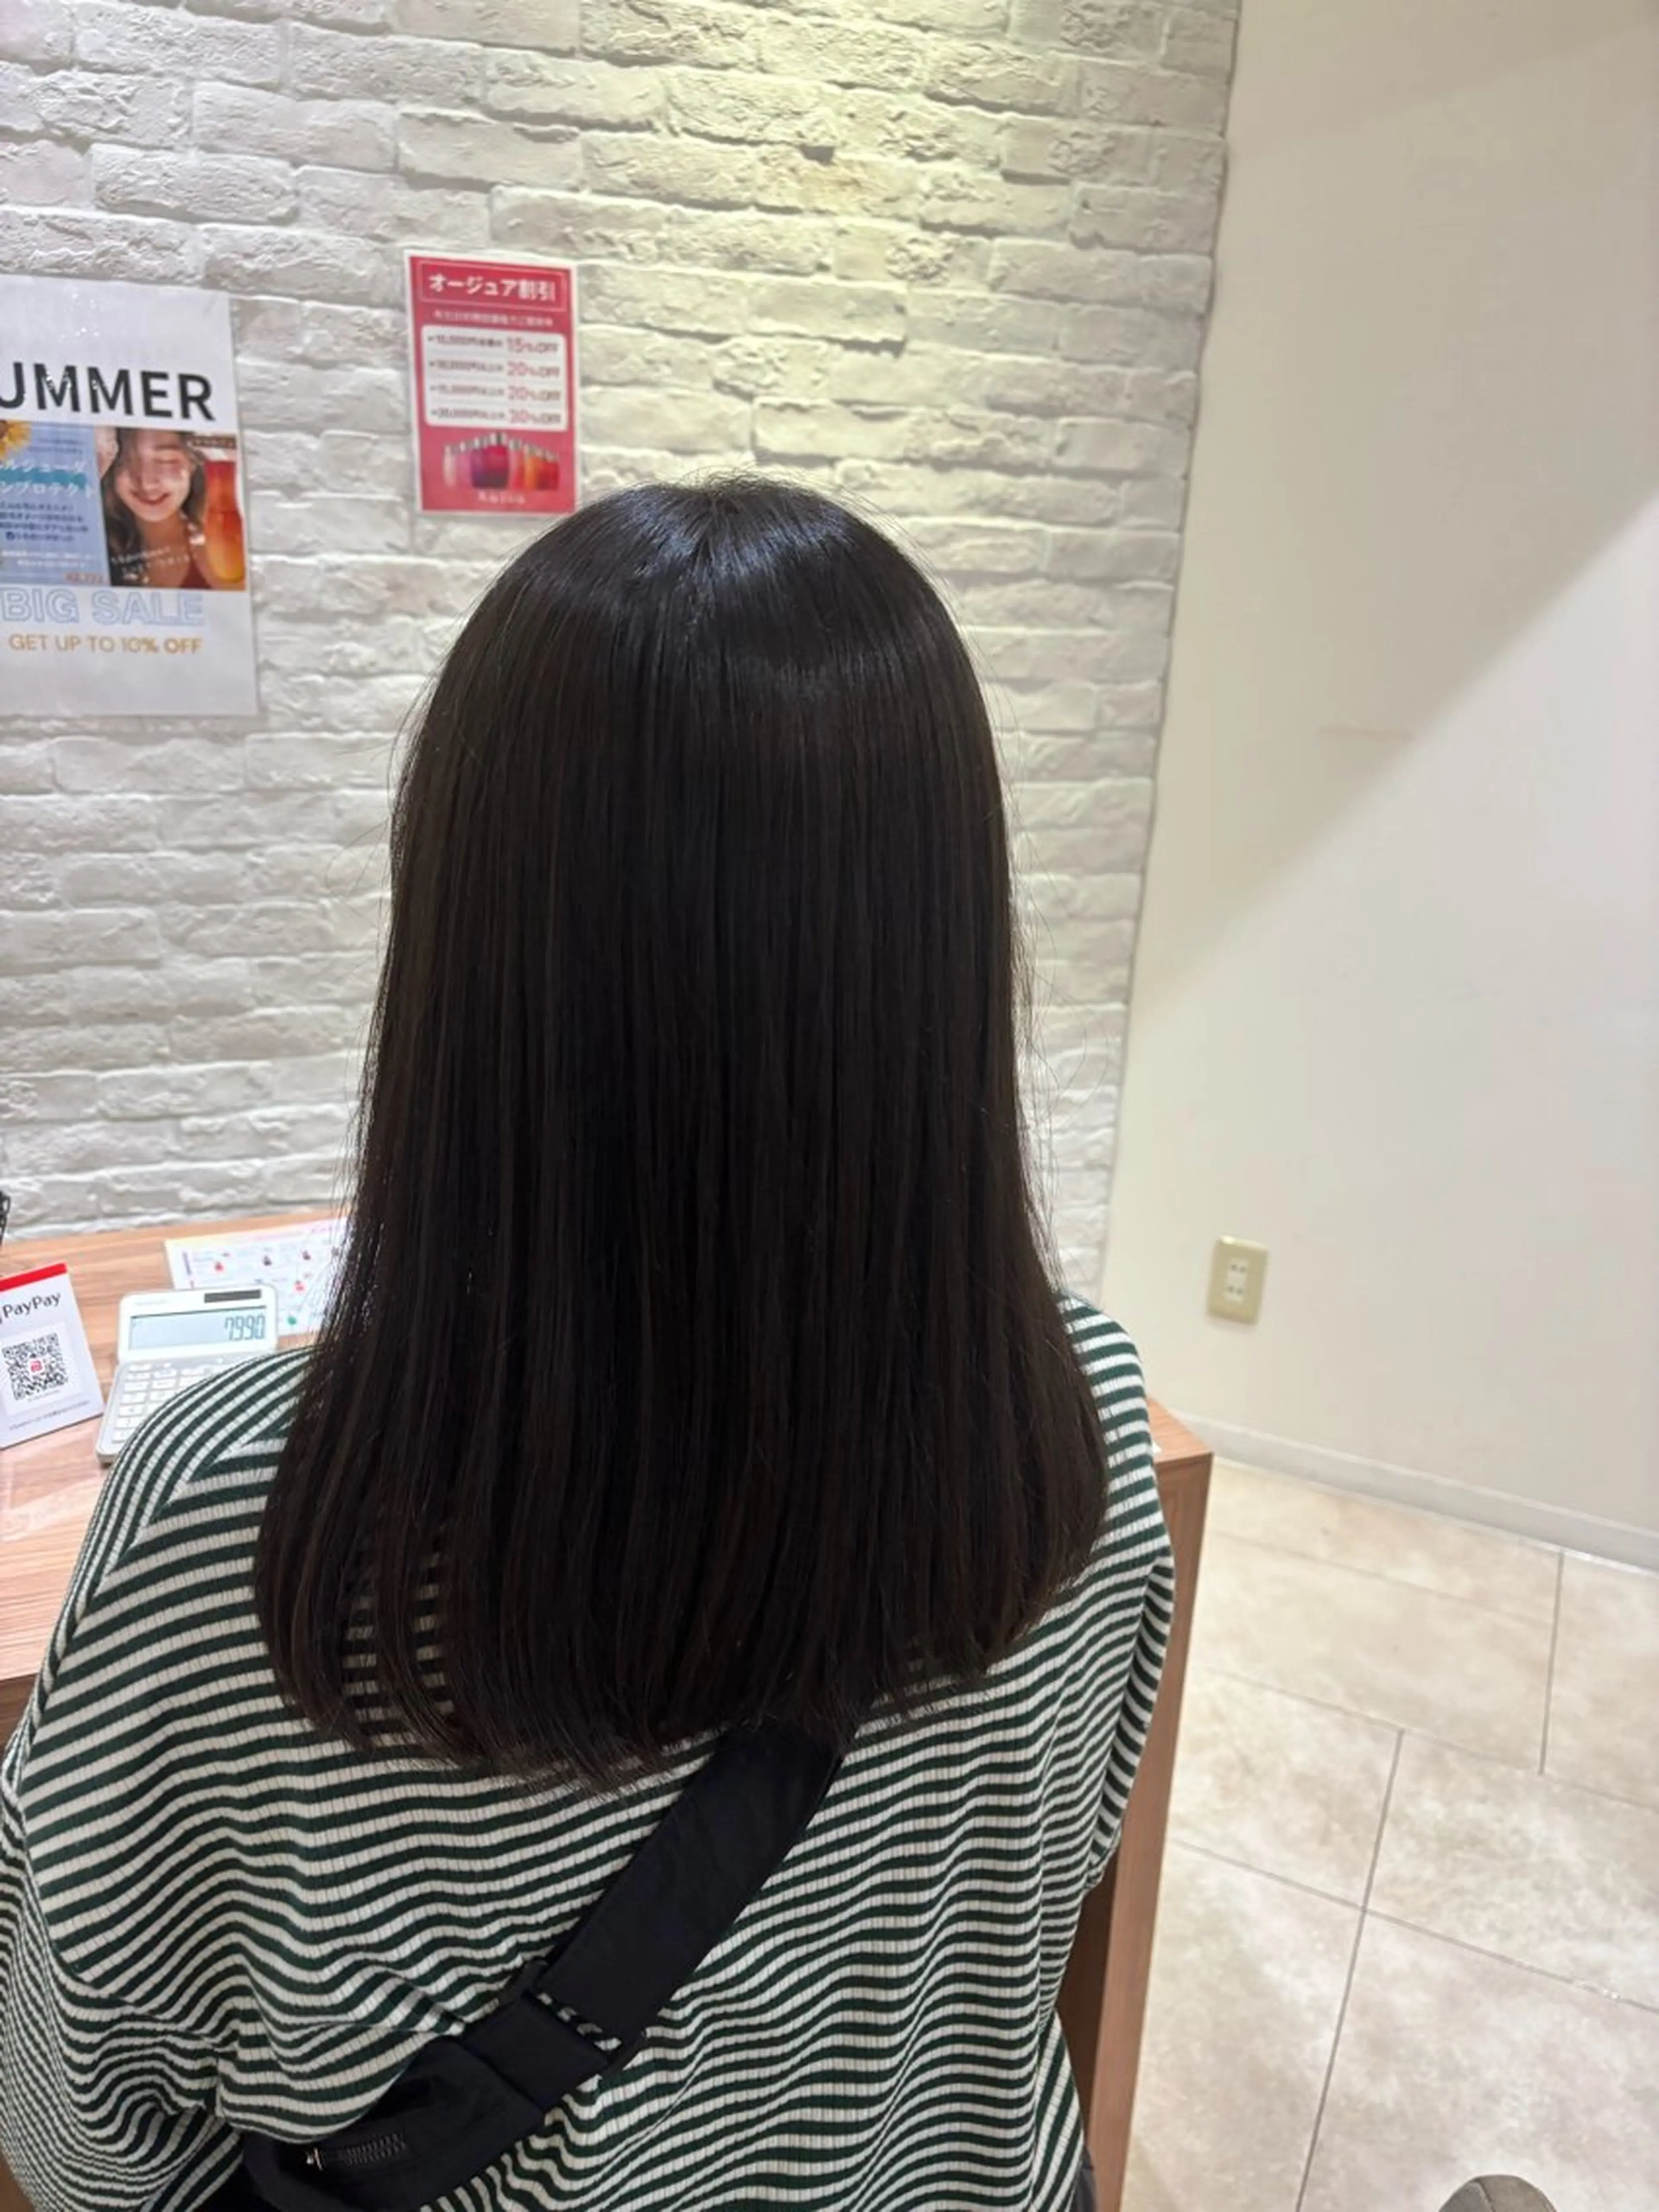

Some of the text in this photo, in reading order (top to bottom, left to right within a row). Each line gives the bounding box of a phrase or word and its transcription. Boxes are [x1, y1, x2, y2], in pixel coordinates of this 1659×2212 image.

[429, 273, 556, 301] オージュア割引
[0, 362, 216, 421] UMMER
[1, 587, 205, 626] BIG SALE
[9, 633, 203, 655] GET UP TO 10% OFF
[3, 1293, 61, 1319] PayPay
[224, 1314, 266, 1341] 7990
